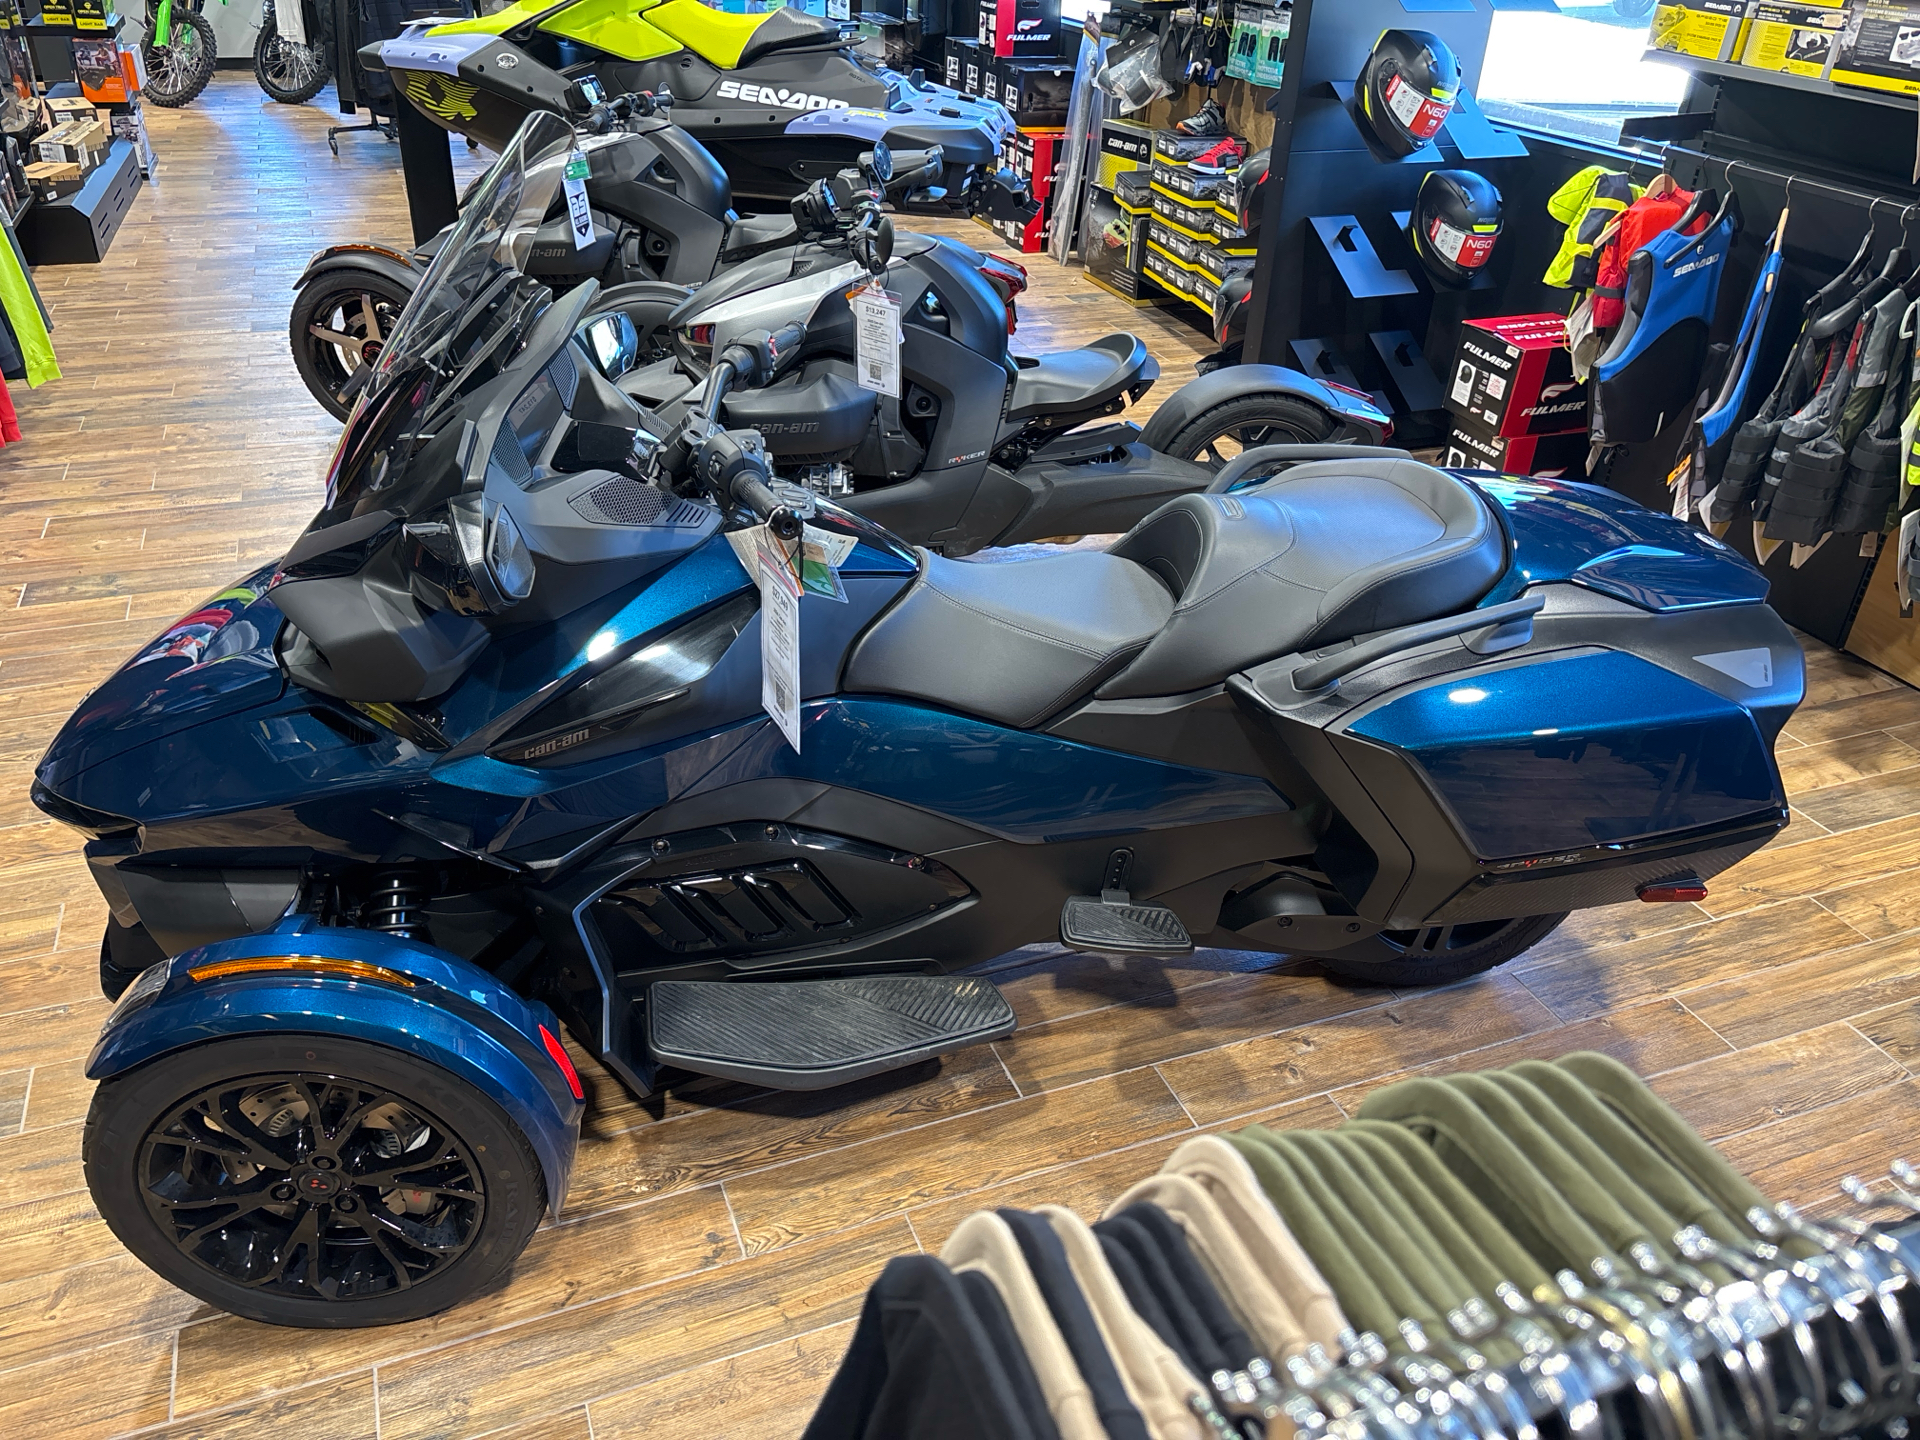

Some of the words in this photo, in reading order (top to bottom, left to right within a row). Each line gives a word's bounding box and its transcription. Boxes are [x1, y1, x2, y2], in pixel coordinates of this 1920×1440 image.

[1423, 103, 1448, 120] N60
[1107, 137, 1138, 153] can-am
[1466, 239, 1493, 249] N60
[865, 305, 887, 316] $13,247
[1463, 341, 1512, 371] FULMER
[1520, 401, 1586, 417] FULMER
[1452, 428, 1500, 458] FULMER
[948, 450, 986, 465] RYKER
[524, 728, 590, 760] can-am
